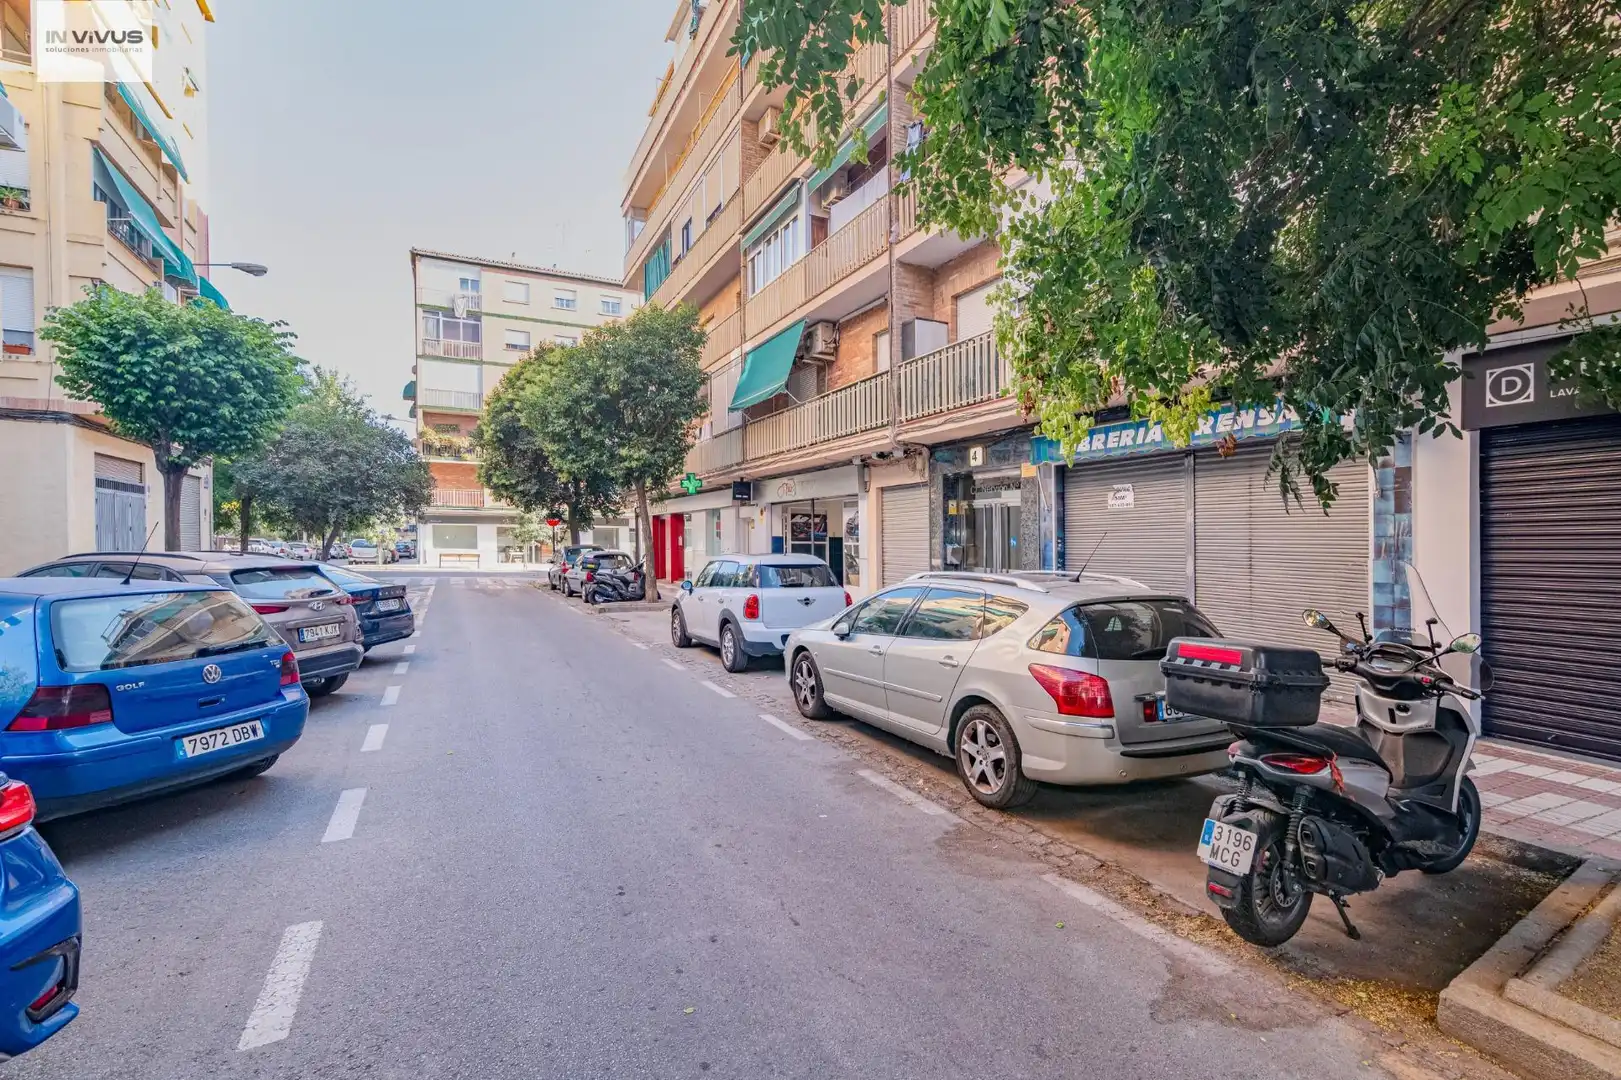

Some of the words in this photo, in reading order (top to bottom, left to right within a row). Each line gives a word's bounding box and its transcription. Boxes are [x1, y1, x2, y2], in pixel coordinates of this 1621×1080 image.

[1501, 376, 1522, 396] D
[1060, 424, 1163, 455] BRERIA
[1180, 402, 1301, 436] RENSA
[972, 450, 977, 462] 4
[305, 627, 323, 639] 7941
[325, 623, 338, 634] KJK
[116, 682, 145, 692] GOLF
[188, 731, 229, 755] 7972
[232, 723, 259, 743] DBW
[1214, 825, 1253, 851] 3196
[1209, 843, 1241, 868] MCG
